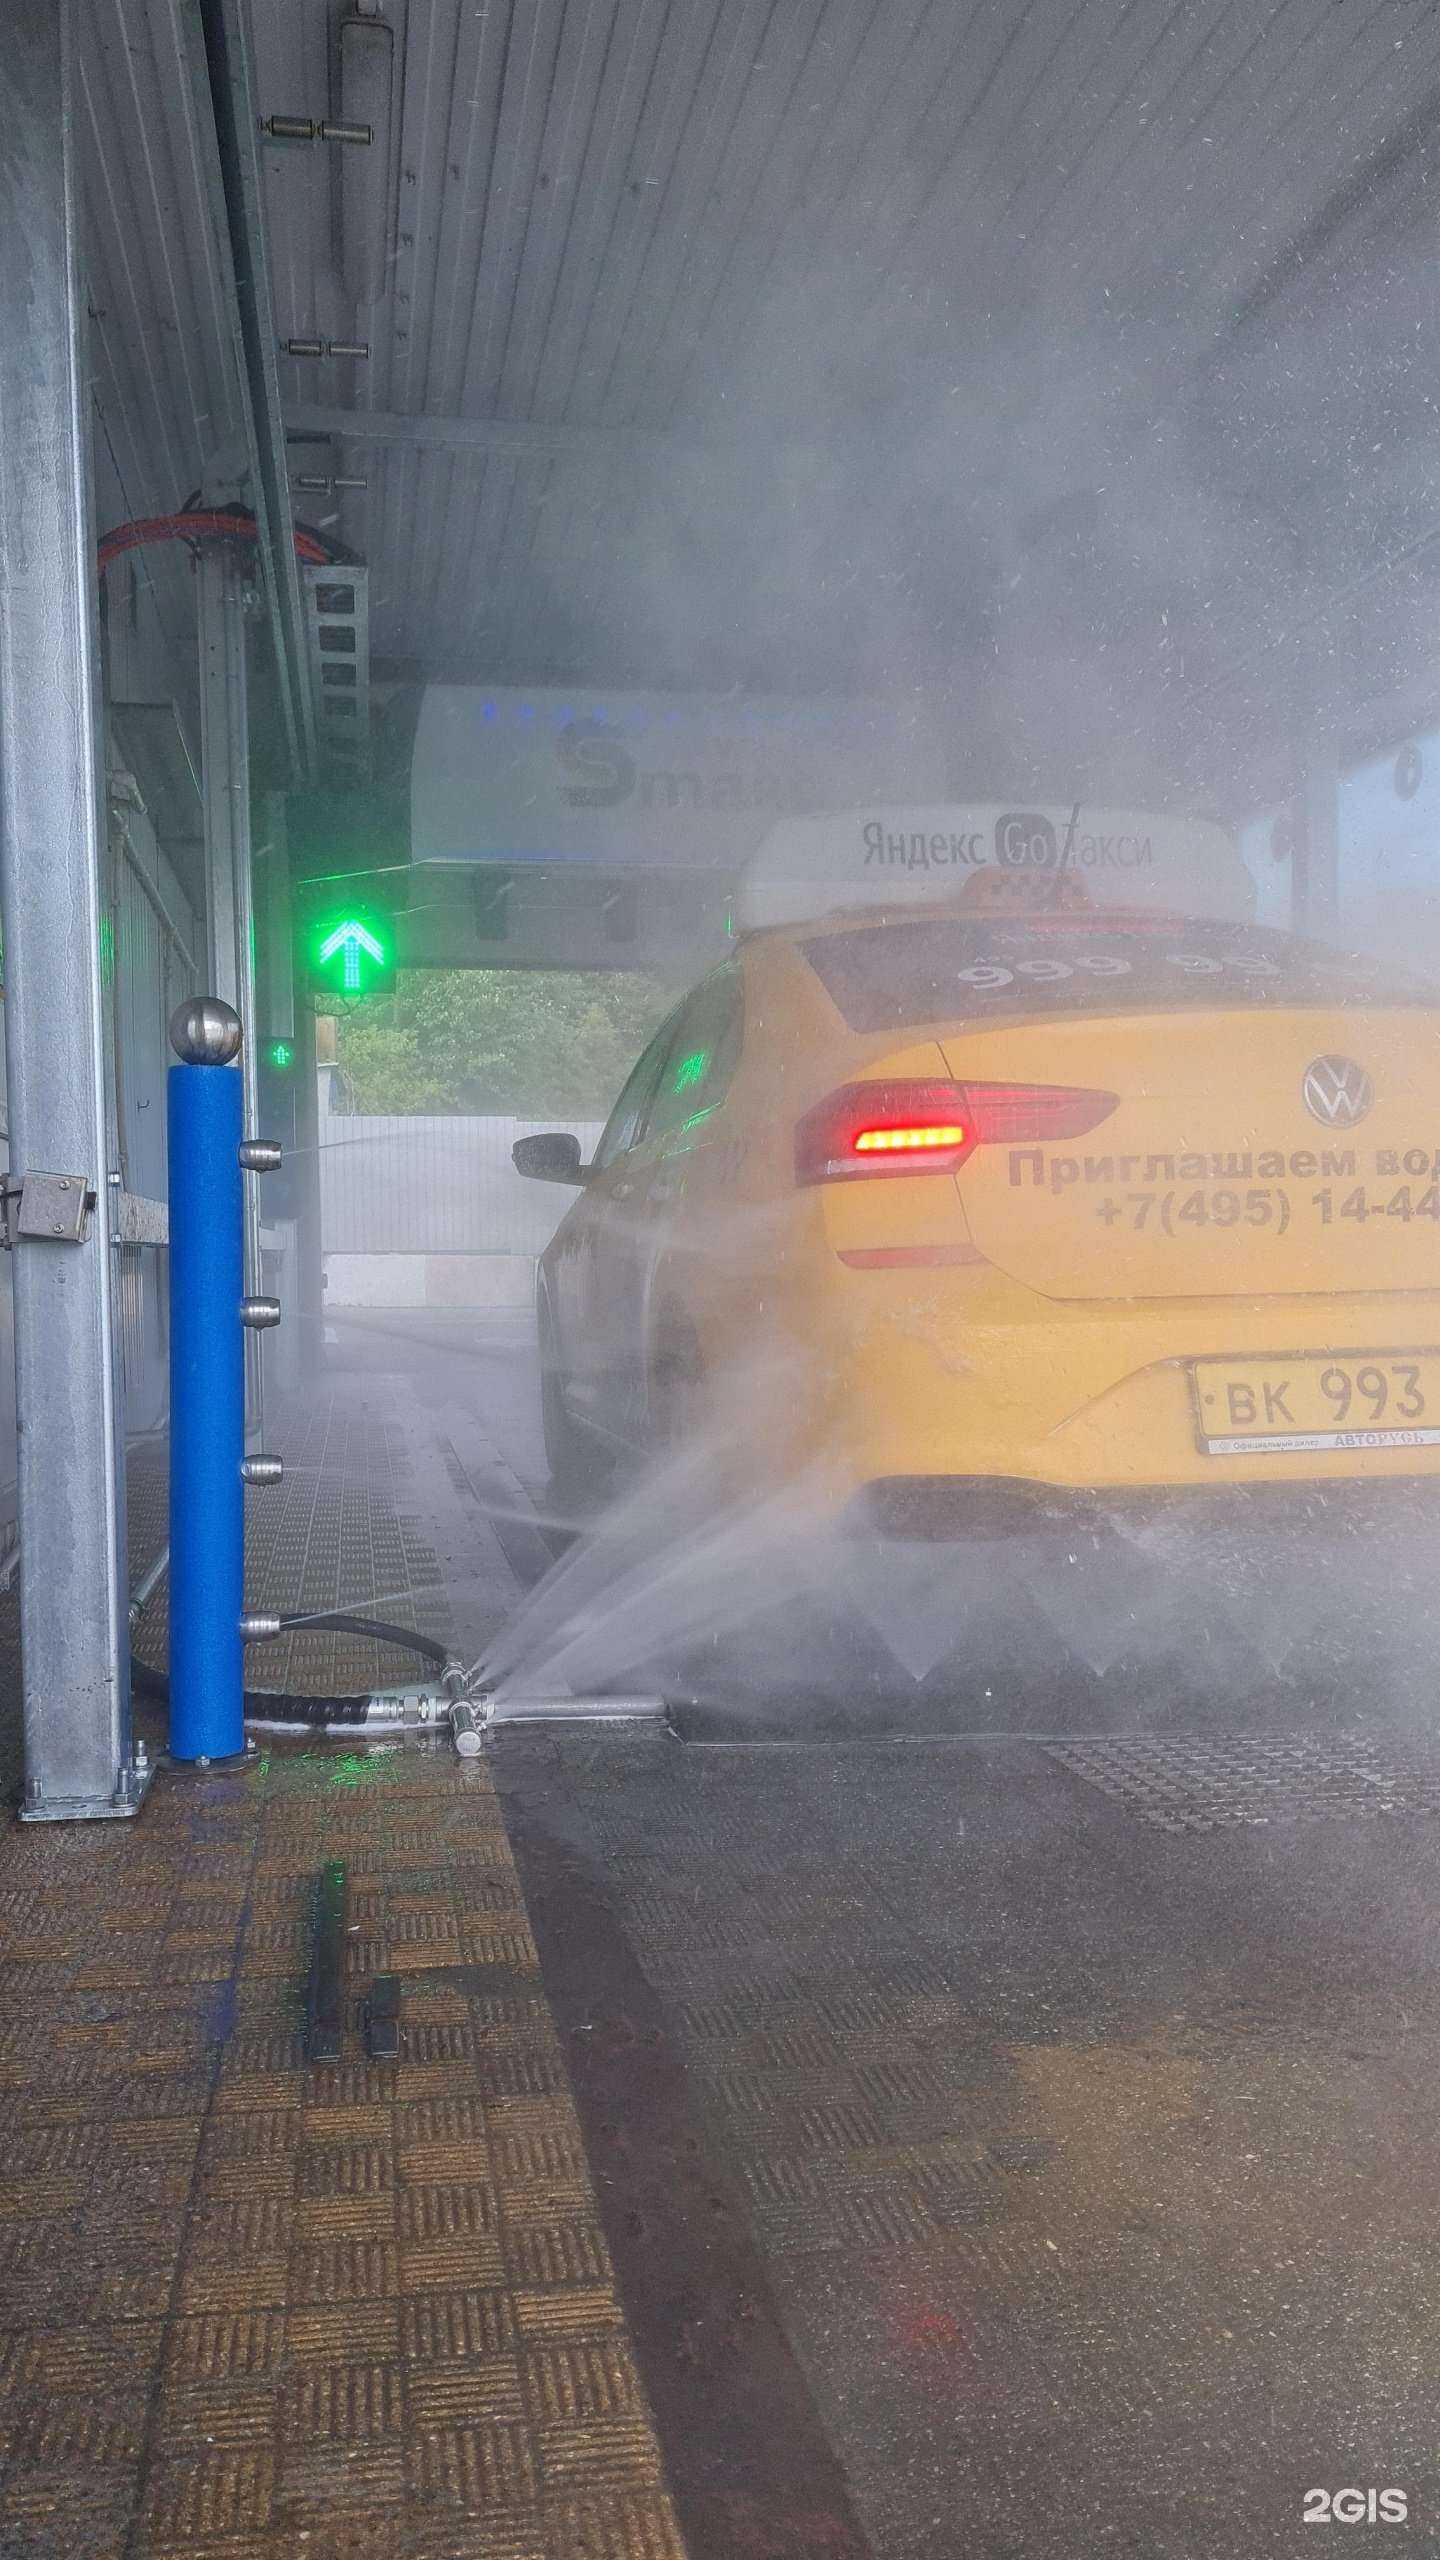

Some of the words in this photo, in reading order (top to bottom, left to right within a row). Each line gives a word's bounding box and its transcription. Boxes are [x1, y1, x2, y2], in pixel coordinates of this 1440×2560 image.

[862, 821, 989, 871] Яндекс
[1003, 822, 1050, 866] Go
[957, 955, 1133, 989] 999
[1008, 1148, 1356, 1195] Приглашаем
[1375, 1147, 1440, 1183] во
[1096, 1187, 1291, 1237] +7(495)
[1226, 1380, 1295, 1425] ВК
[1320, 1364, 1425, 1422] 993
